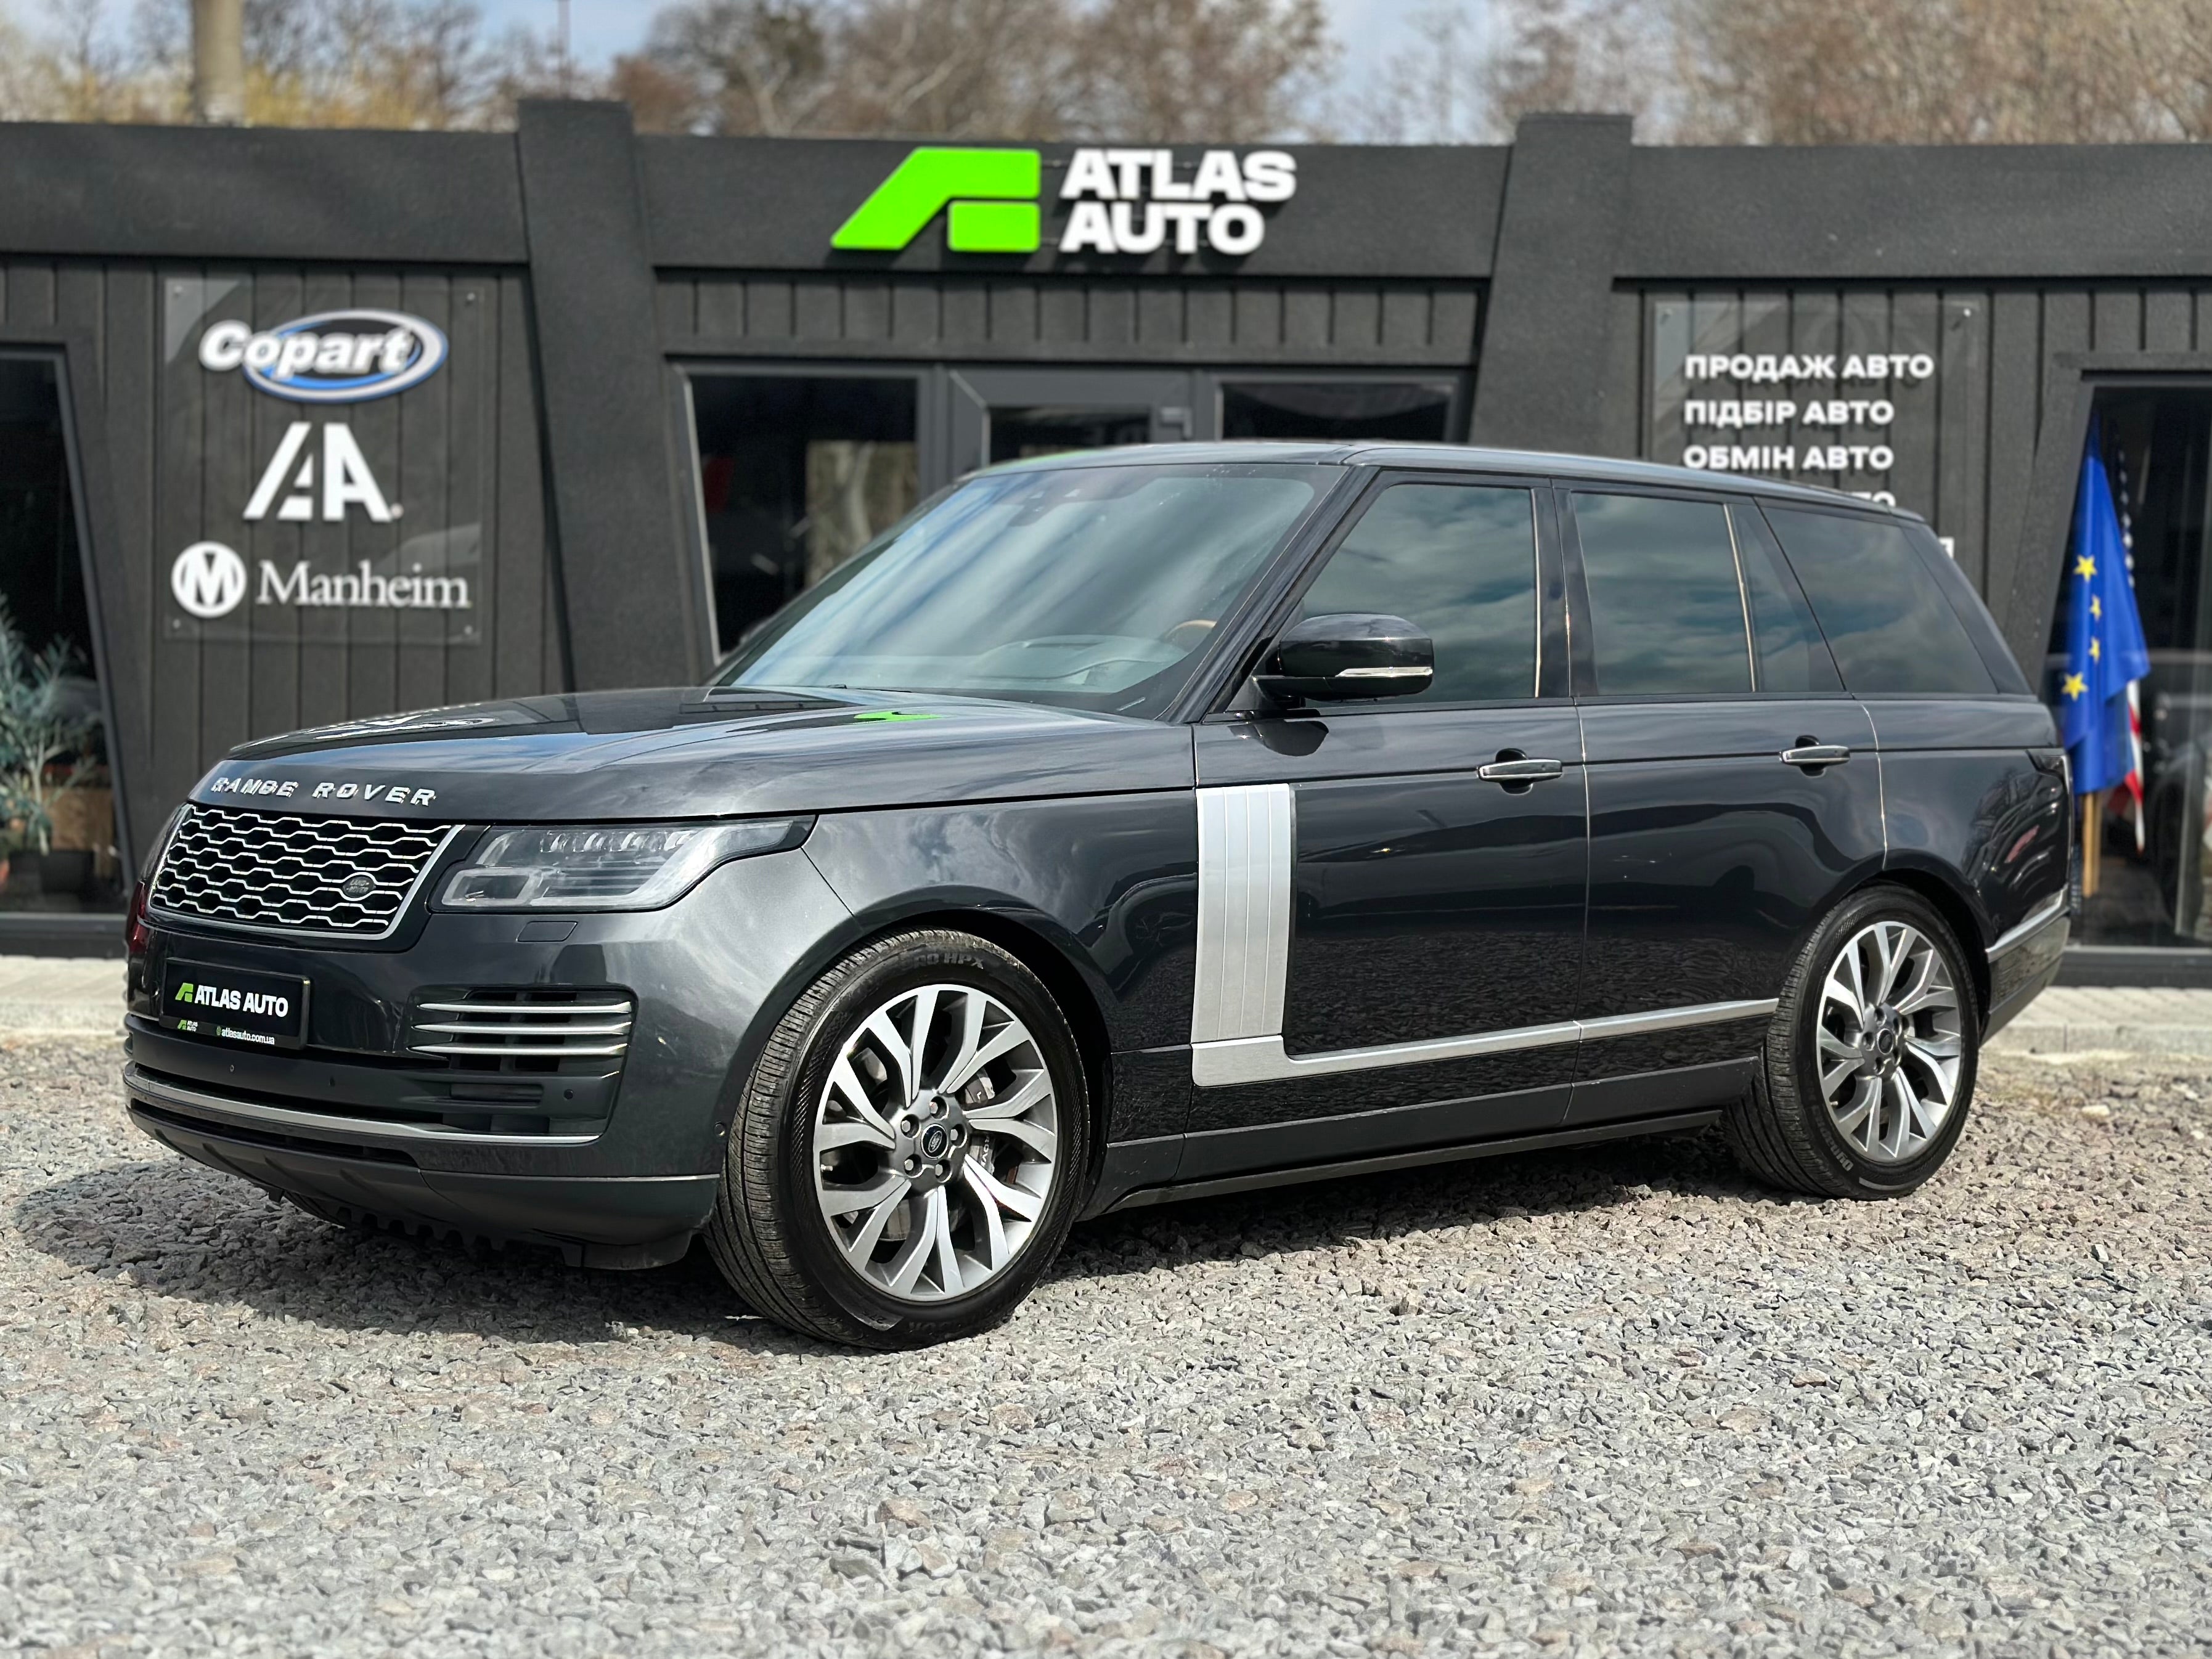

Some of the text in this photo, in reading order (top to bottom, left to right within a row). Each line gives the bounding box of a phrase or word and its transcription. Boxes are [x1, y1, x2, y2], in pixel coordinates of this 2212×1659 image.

[1060, 149, 1297, 202] ATLAS
[1059, 202, 1265, 255] AUTO
[200, 320, 413, 380] Copart
[1685, 355, 1935, 383] ПРОДАЖ АВТО
[1684, 401, 1895, 428] ПІДБІР АВТО
[1683, 446, 1894, 470] ОБМІН АВТО
[258, 561, 470, 607] Manheim
[211, 777, 436, 806] RANGE ROVER
[194, 985, 288, 1017] ATLAS AUTO
[221, 1028, 275, 1045] atlasauto.com.ua
